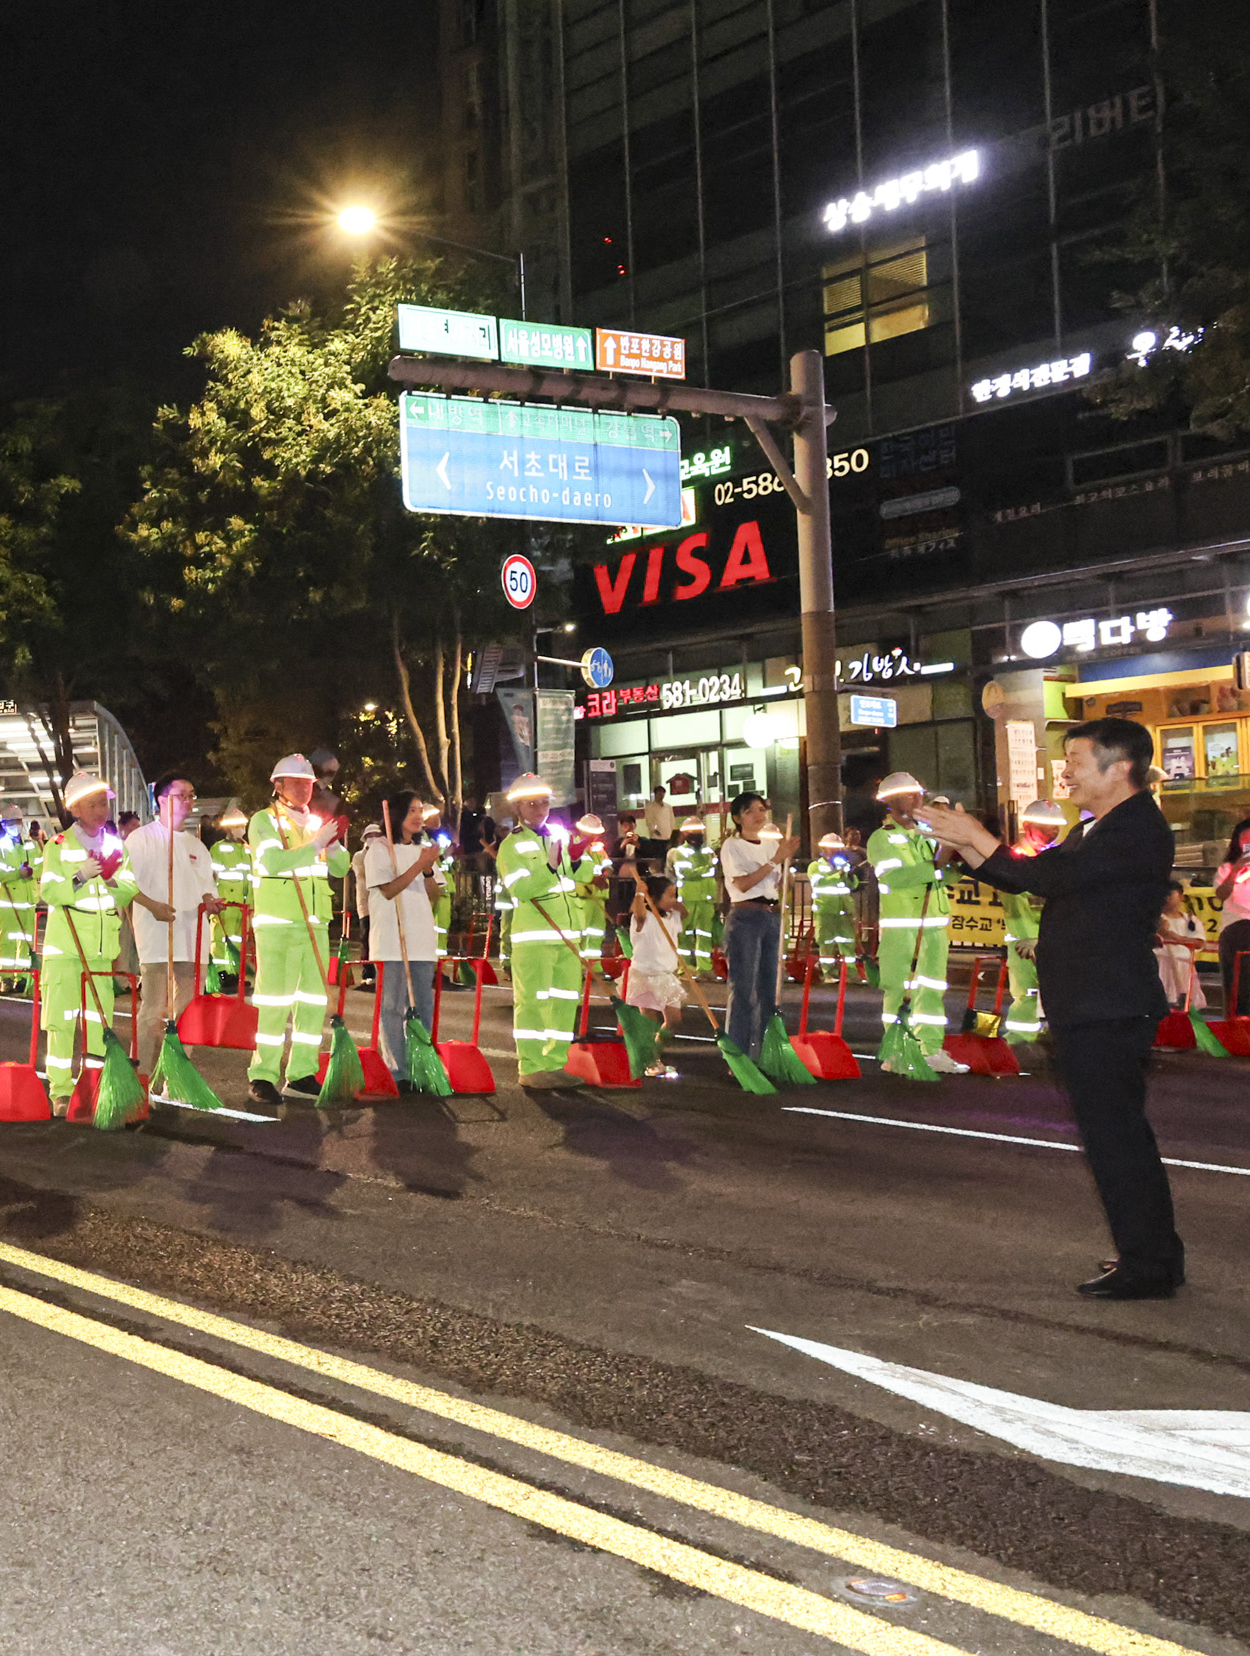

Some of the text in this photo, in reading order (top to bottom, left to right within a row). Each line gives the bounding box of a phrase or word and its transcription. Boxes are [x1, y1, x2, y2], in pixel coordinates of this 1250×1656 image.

[507, 328, 575, 362] 서울성모병원
[619, 335, 683, 361] 반포한강공원
[619, 355, 682, 373] Banpo Hangang Park
[428, 402, 483, 426] 내방역
[521, 411, 587, 436] 고속터미널
[606, 419, 655, 443] 강남역
[499, 449, 593, 481] 서초대로
[486, 480, 612, 508] Seocho-daero
[593, 520, 772, 614] VISA
[509, 570, 529, 595] 50
[586, 689, 618, 718] 코라
[619, 683, 659, 704] 부동산
[661, 672, 742, 709] 581-0234
[951, 915, 992, 932] 잠수교
